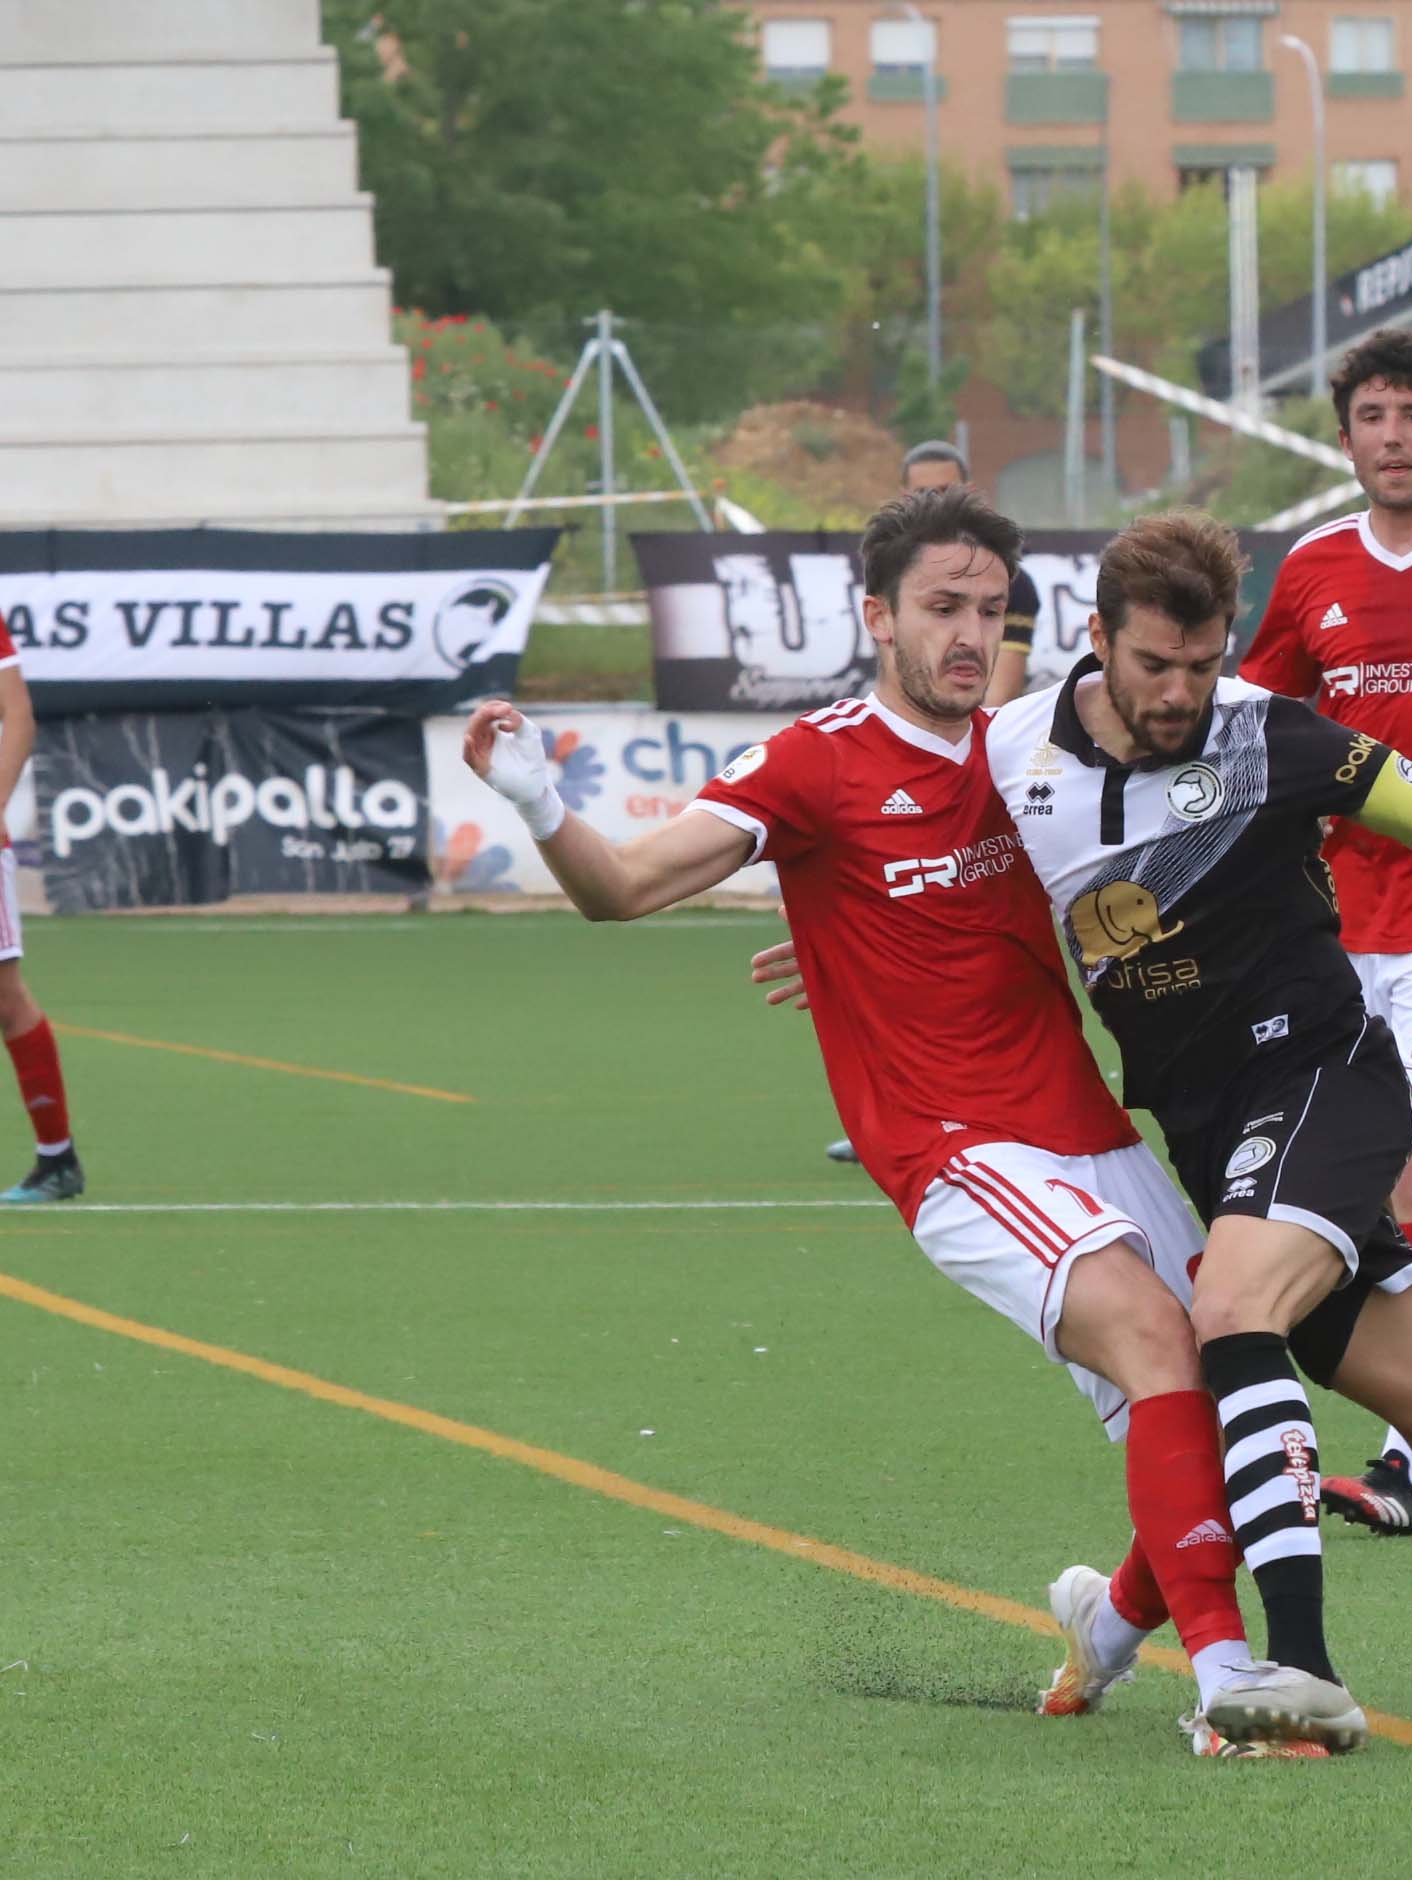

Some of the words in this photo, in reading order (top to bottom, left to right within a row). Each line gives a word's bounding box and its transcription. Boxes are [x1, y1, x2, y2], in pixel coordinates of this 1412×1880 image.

[115, 602, 414, 650] VILLAS
[52, 763, 419, 859] pakipalla
[880, 803, 924, 815] adidas
[1023, 804, 1053, 816] errea
[963, 852, 1015, 883] GROUP
[1222, 1188, 1256, 1204] errea
